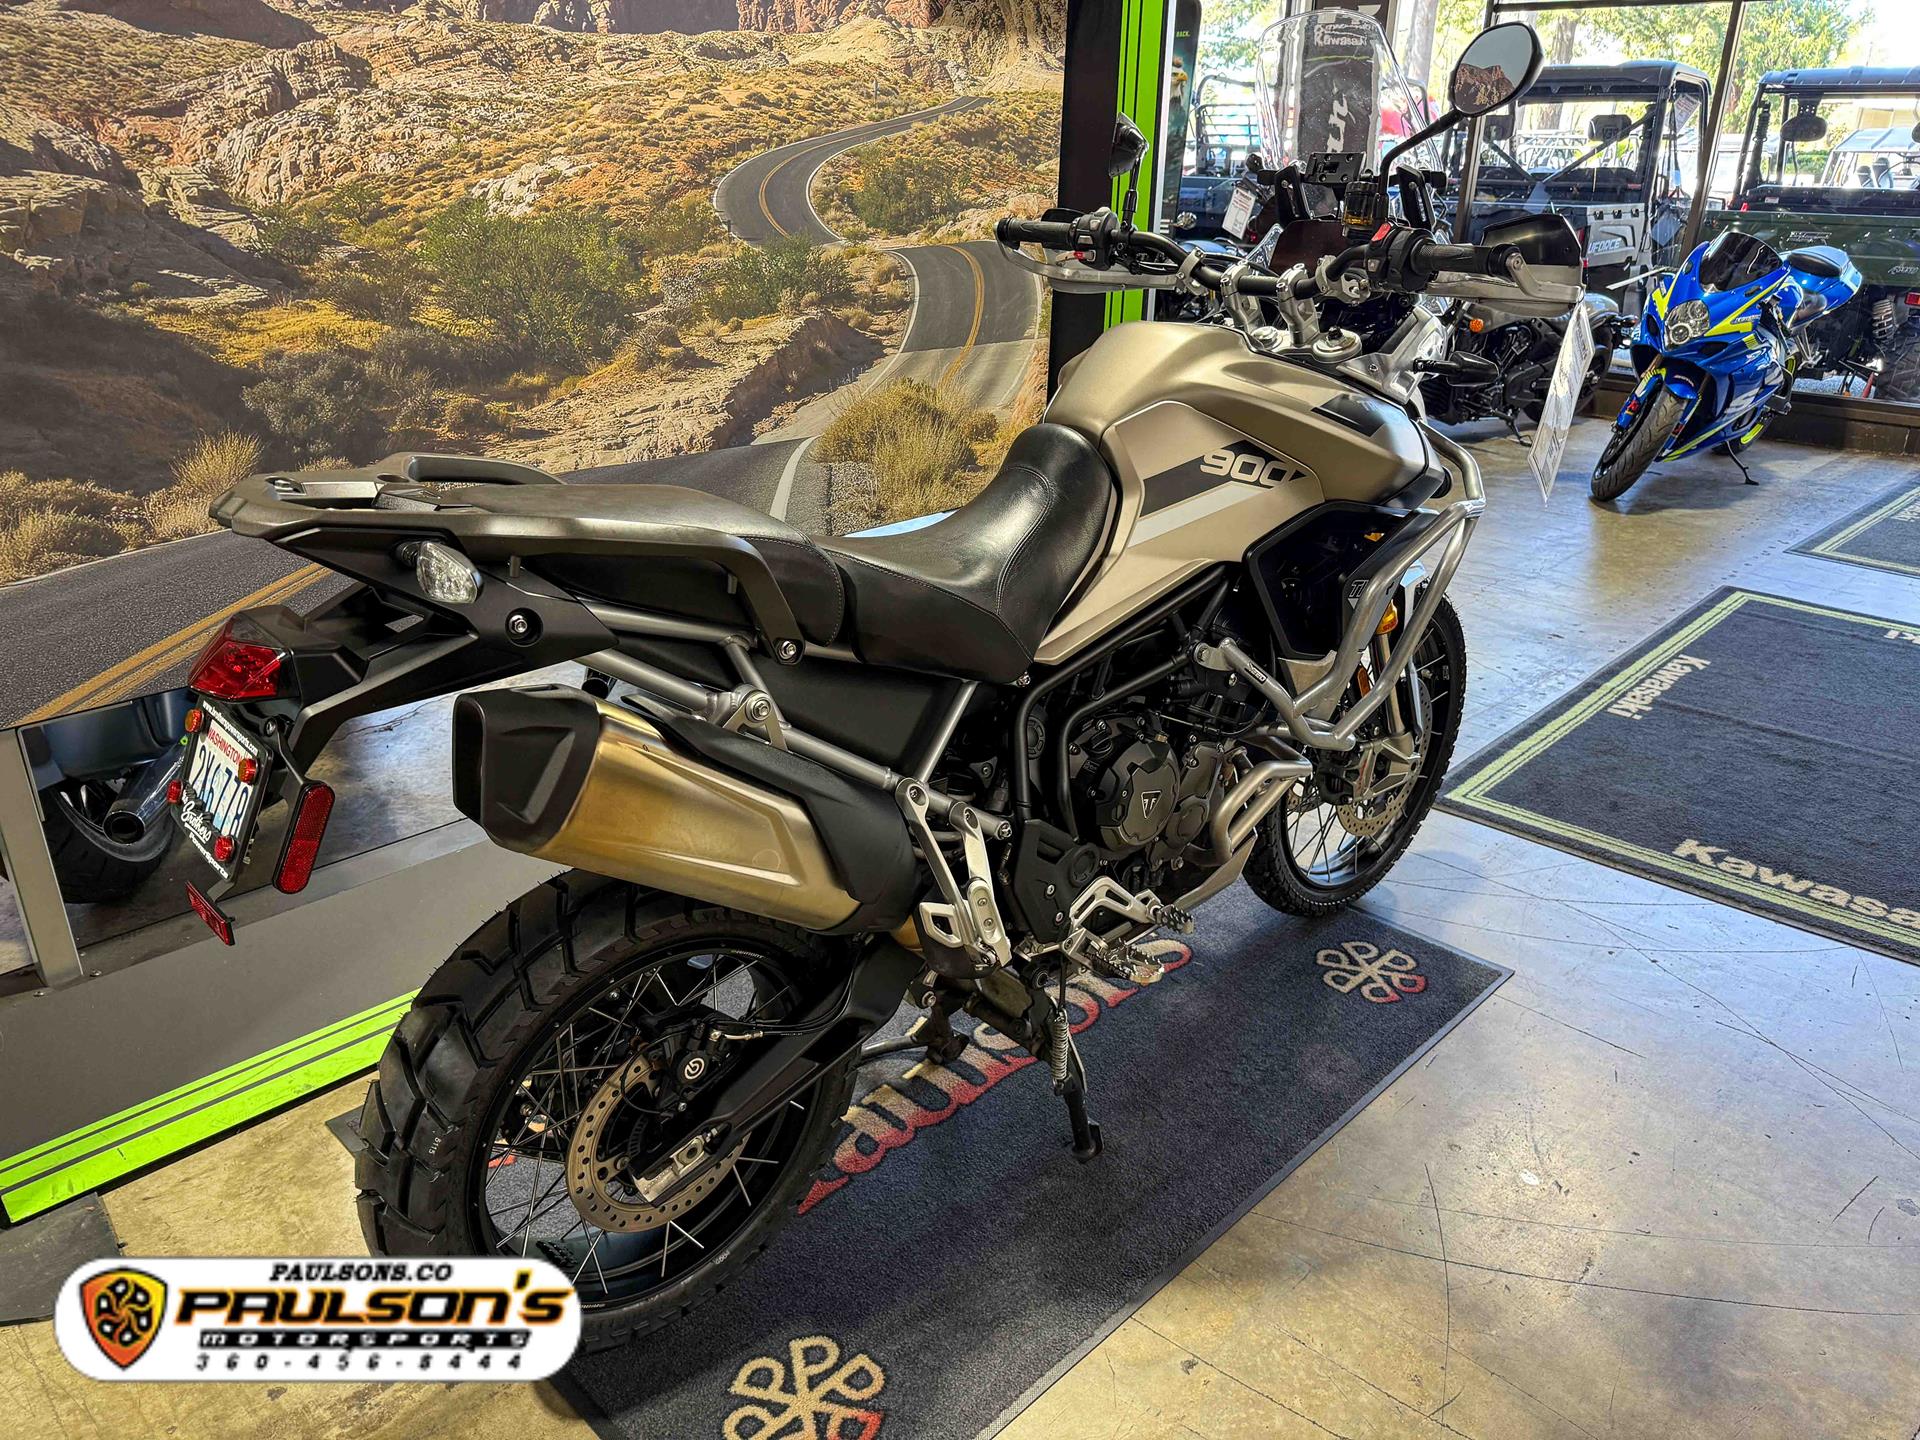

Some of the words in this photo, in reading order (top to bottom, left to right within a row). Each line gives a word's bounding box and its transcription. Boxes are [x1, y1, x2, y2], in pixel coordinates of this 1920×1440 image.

[1199, 449, 1290, 487] 900
[1607, 653, 1712, 720] Kawasaki
[193, 744, 250, 840] 2X6778
